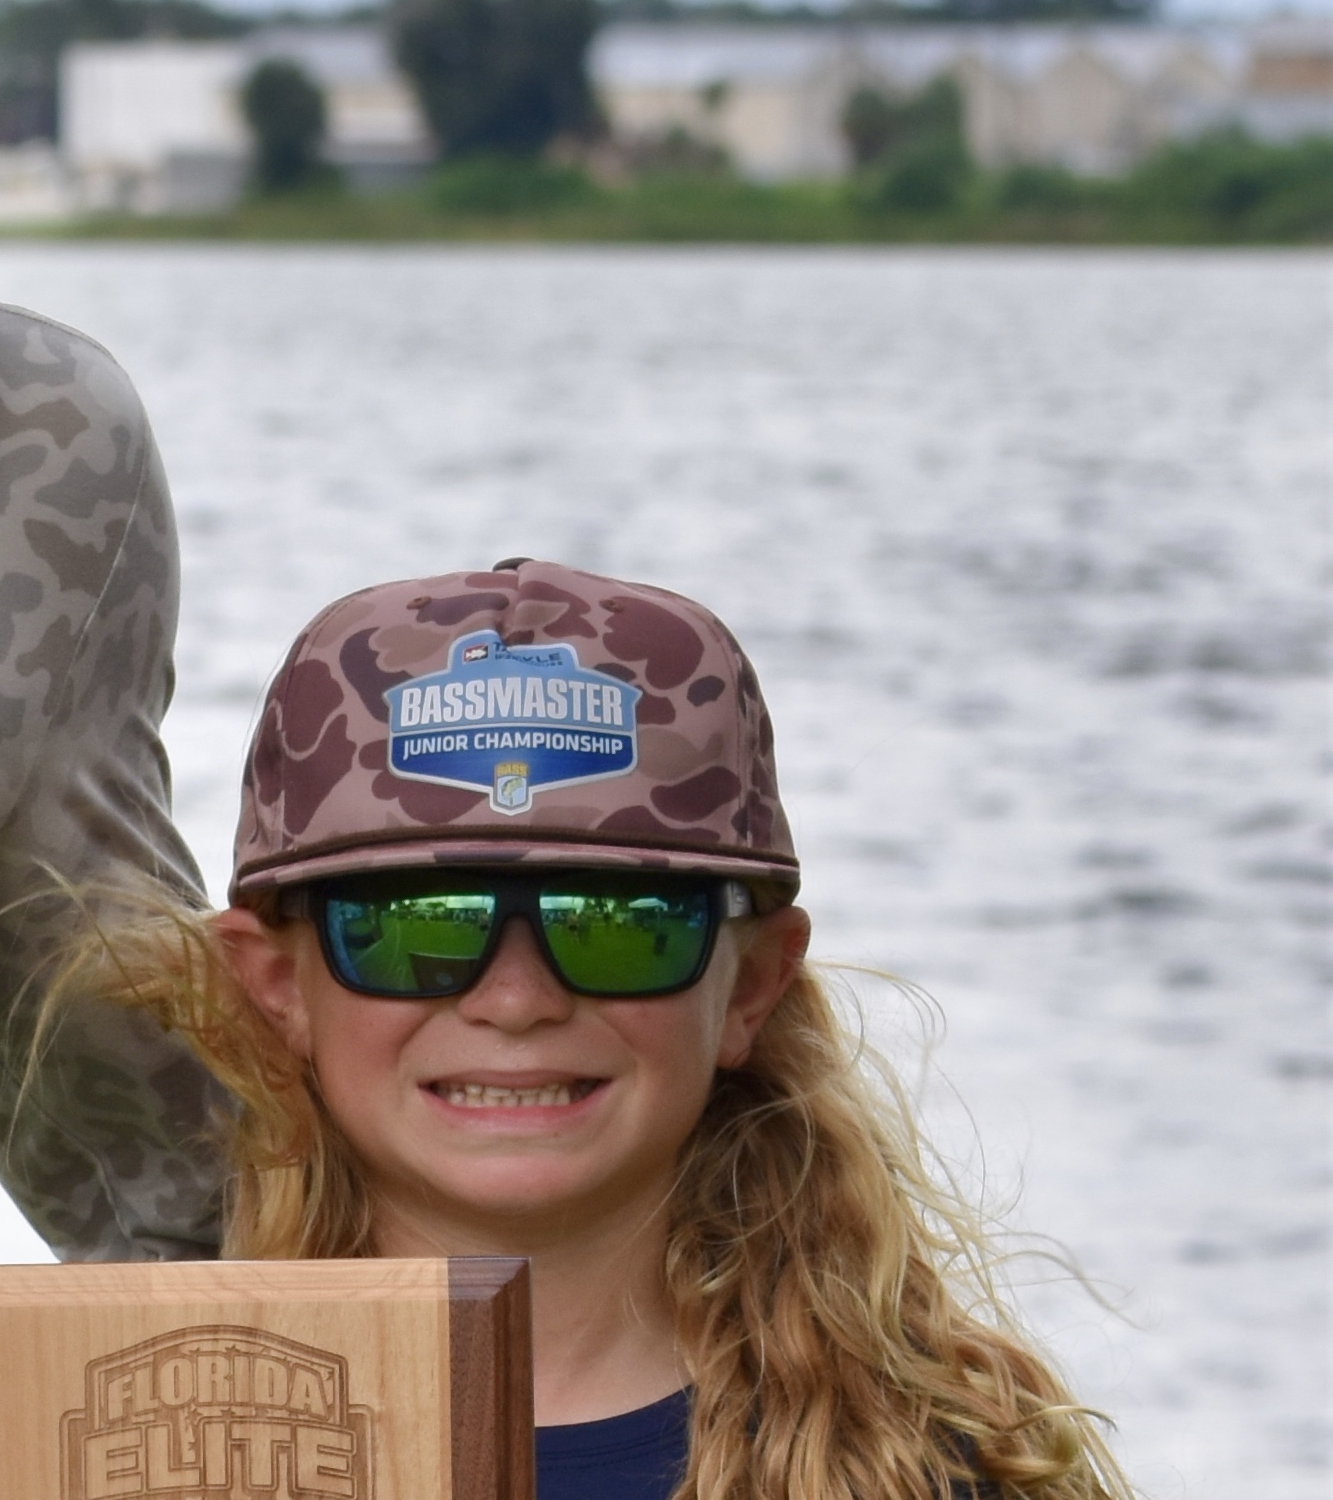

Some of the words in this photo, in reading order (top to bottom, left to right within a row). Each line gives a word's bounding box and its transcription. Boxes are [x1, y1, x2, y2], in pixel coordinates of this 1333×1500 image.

[400, 677, 624, 727] BASSMASTER
[402, 733, 468, 760] JUNIOR
[474, 732, 624, 755] CHAMPIONSHIP
[106, 1354, 329, 1421] FLORIDA
[85, 1420, 355, 1500] ELITE
